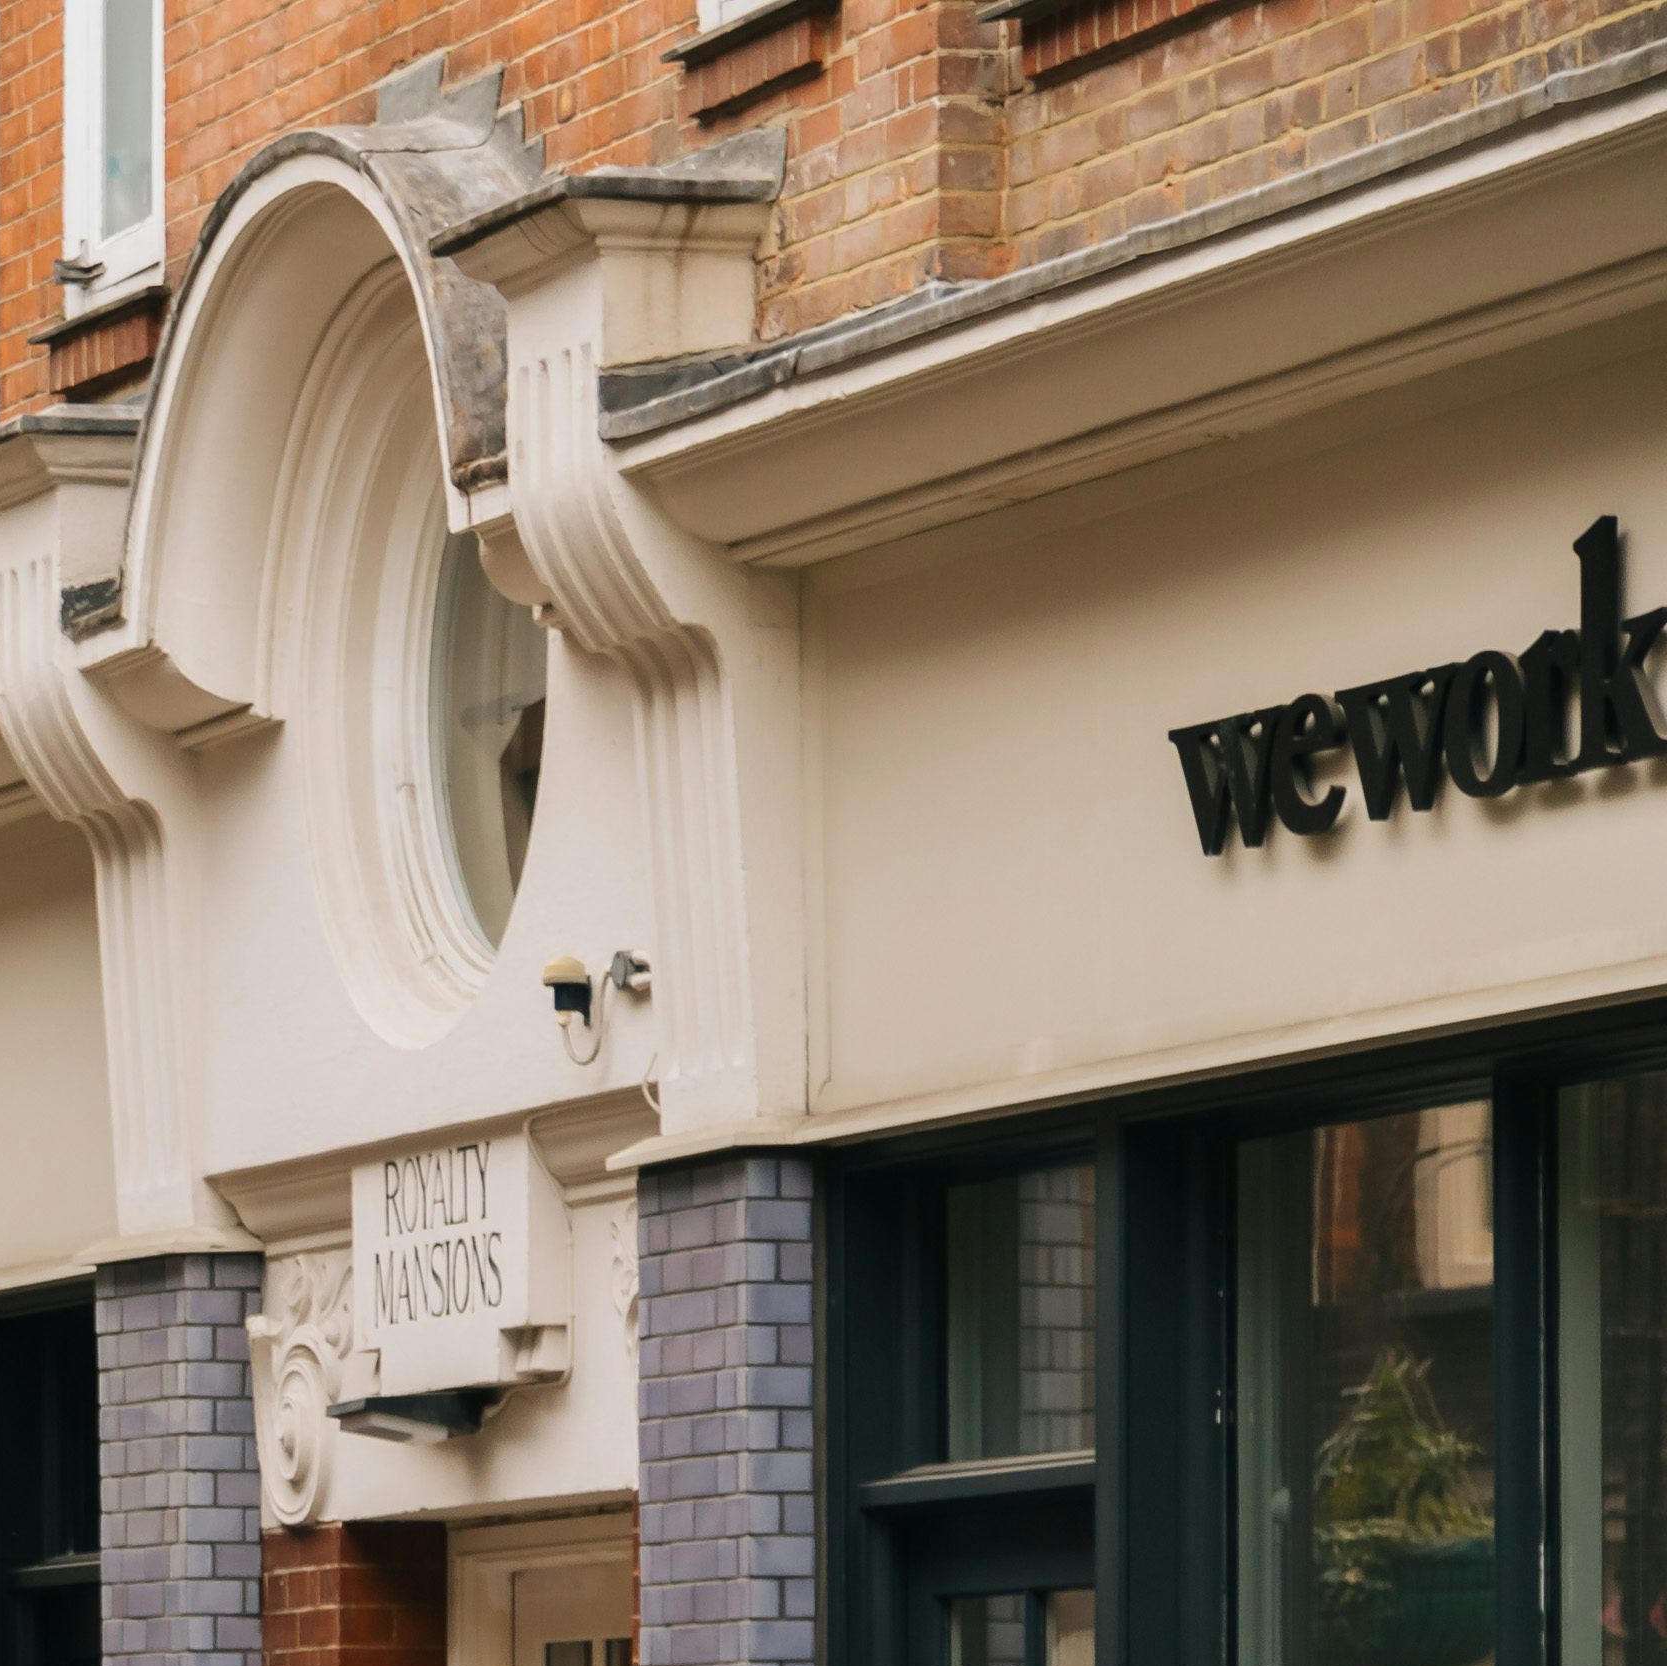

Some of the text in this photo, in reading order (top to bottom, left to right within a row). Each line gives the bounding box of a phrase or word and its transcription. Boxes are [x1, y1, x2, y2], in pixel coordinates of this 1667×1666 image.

[1168, 515, 1667, 857] wework
[384, 1141, 490, 1237] ROYALTY
[375, 1232, 503, 1329] MANSIONS
